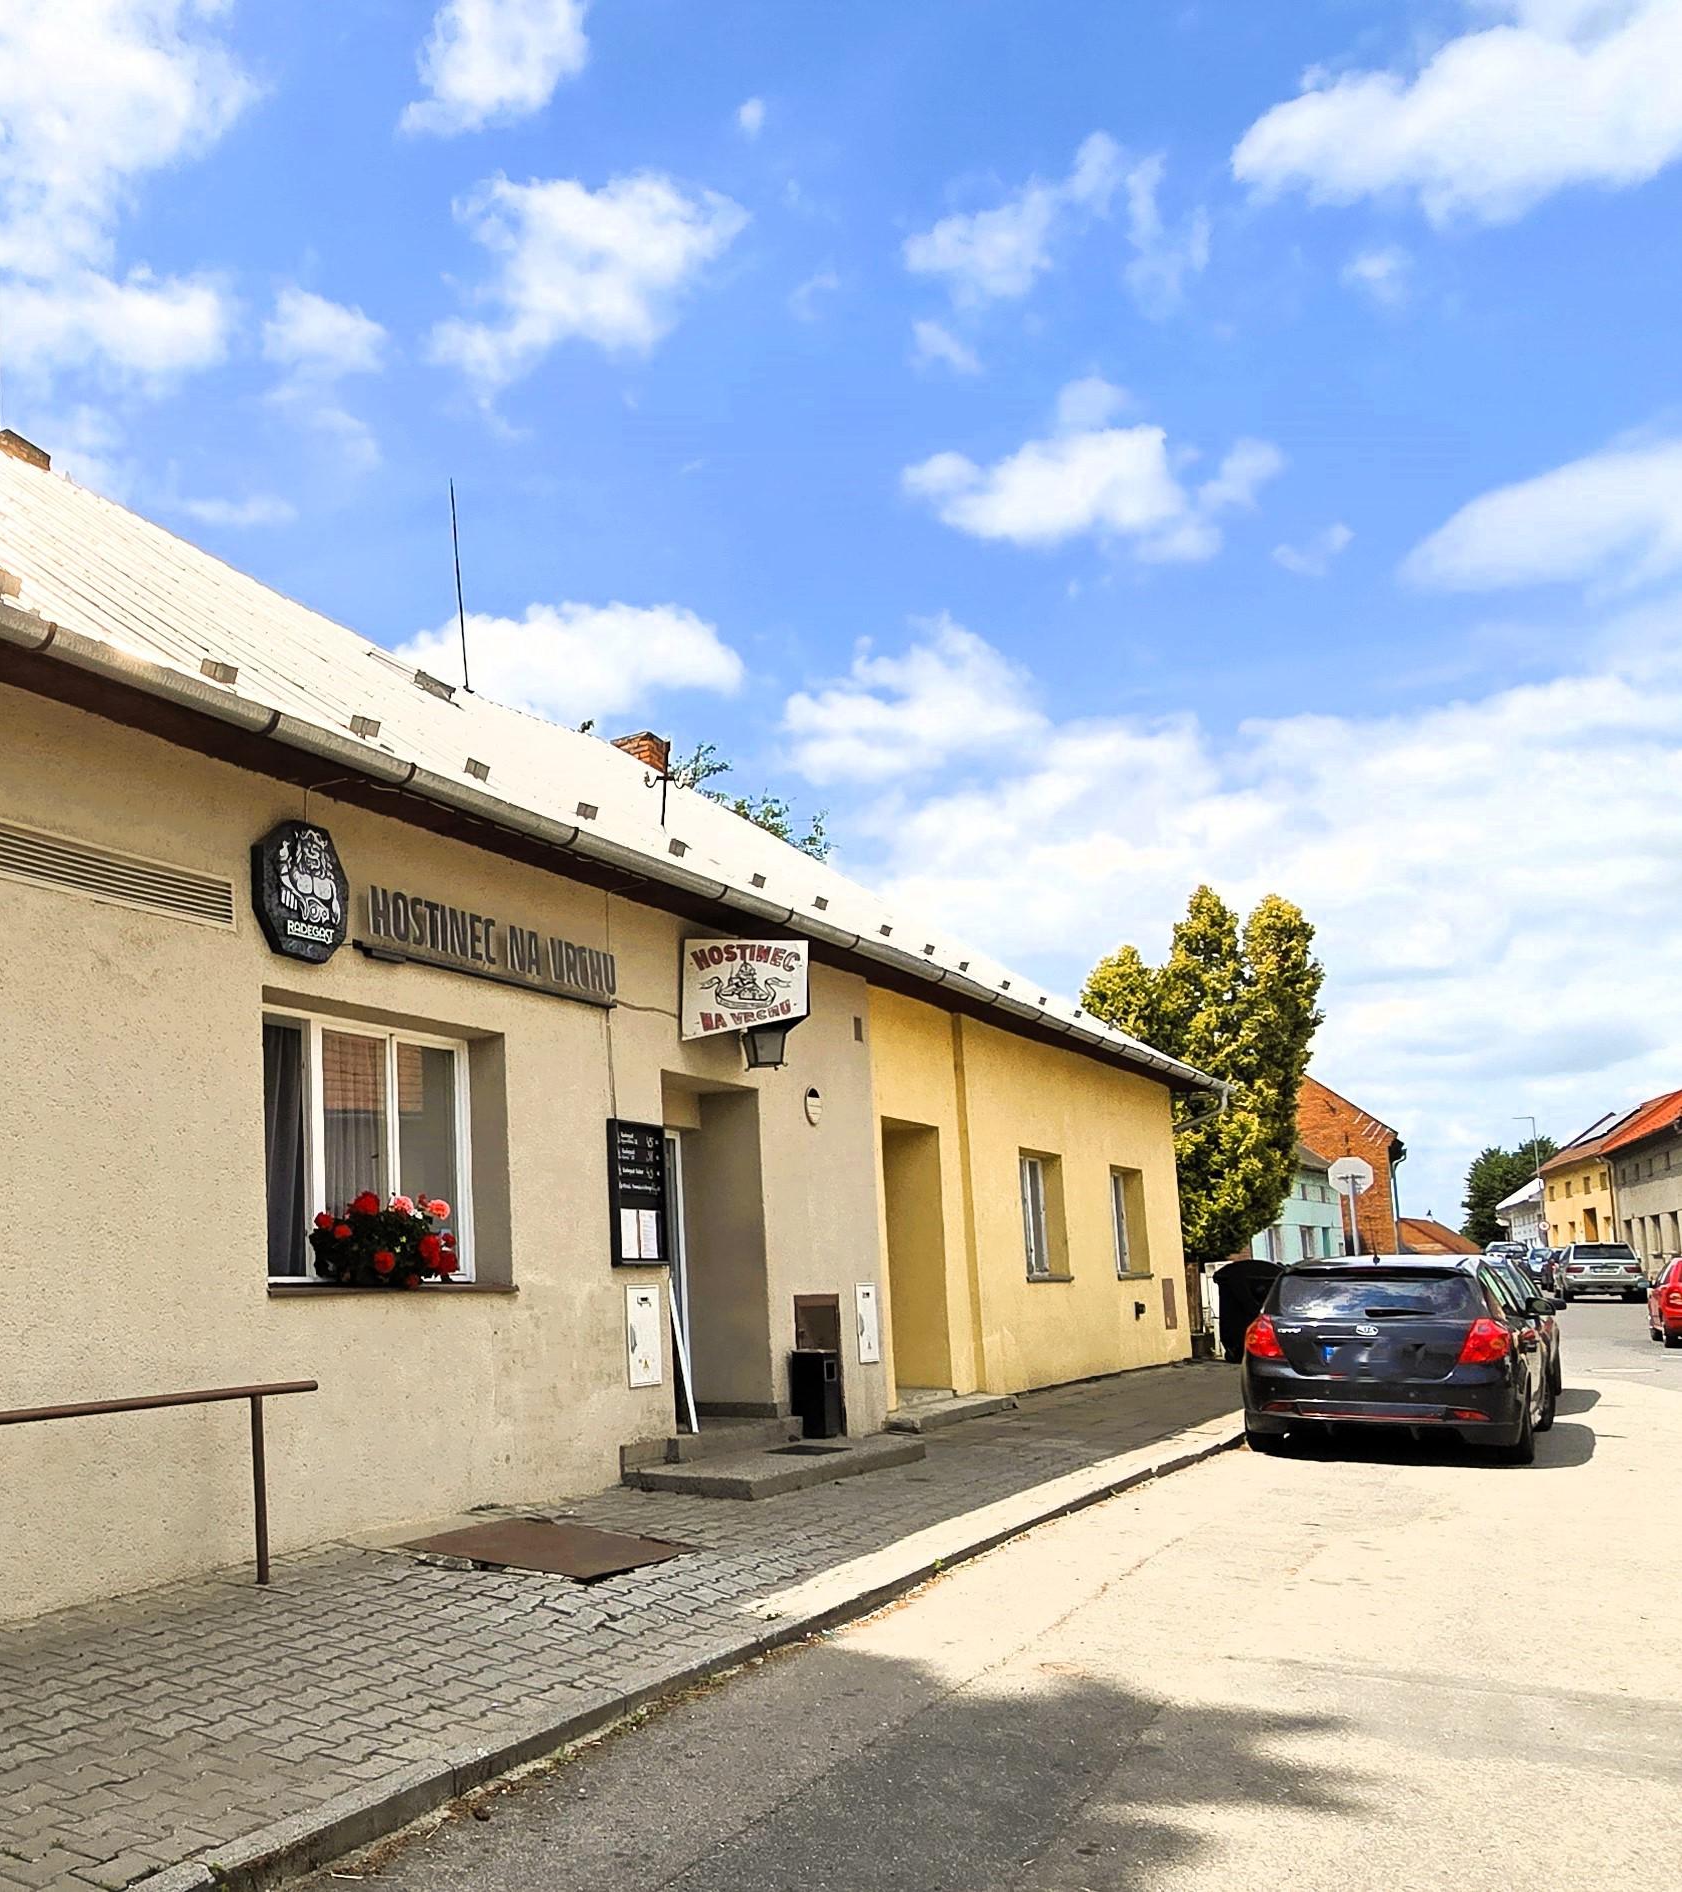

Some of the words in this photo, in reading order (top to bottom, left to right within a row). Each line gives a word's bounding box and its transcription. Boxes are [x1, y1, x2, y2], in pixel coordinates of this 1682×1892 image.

[287, 919, 334, 943] RADEGAST
[369, 885, 497, 965] HOSTINEC
[506, 925, 542, 976] NA
[547, 937, 617, 995] VRCHU
[690, 944, 800, 972] HOSTINEC
[699, 1012, 727, 1031] NA
[730, 999, 792, 1025] VRCHU
